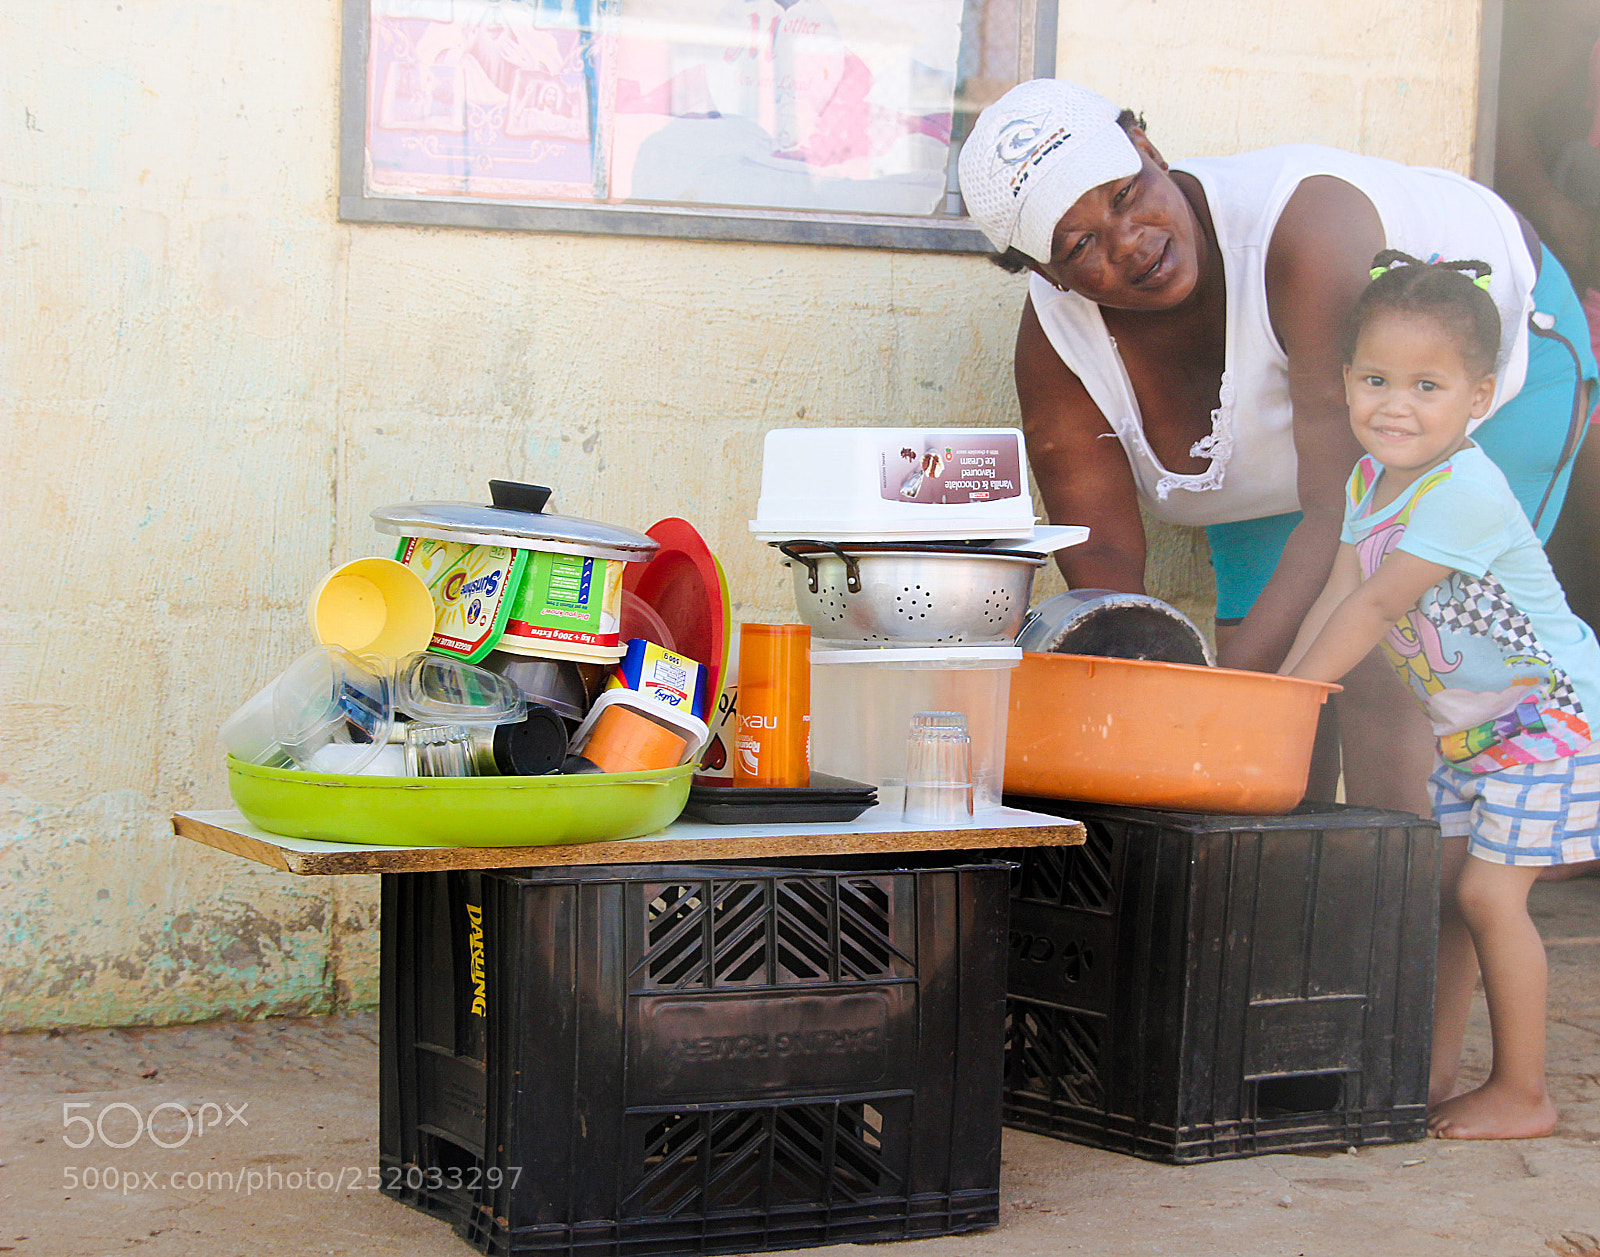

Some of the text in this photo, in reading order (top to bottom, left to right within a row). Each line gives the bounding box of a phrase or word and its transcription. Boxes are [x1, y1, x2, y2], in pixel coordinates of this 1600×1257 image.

[723, 12, 821, 62] Mother
[960, 457, 996, 467] Ice Cream
[961, 468, 996, 479] Flavoured
[944, 479, 1014, 491] Vanilla & Chocolate
[460, 569, 502, 598] Sunshine
[541, 607, 591, 621] Did you know?
[530, 628, 553, 639] Extra
[654, 688, 682, 706] Ruby
[466, 903, 487, 1018] DARLING
